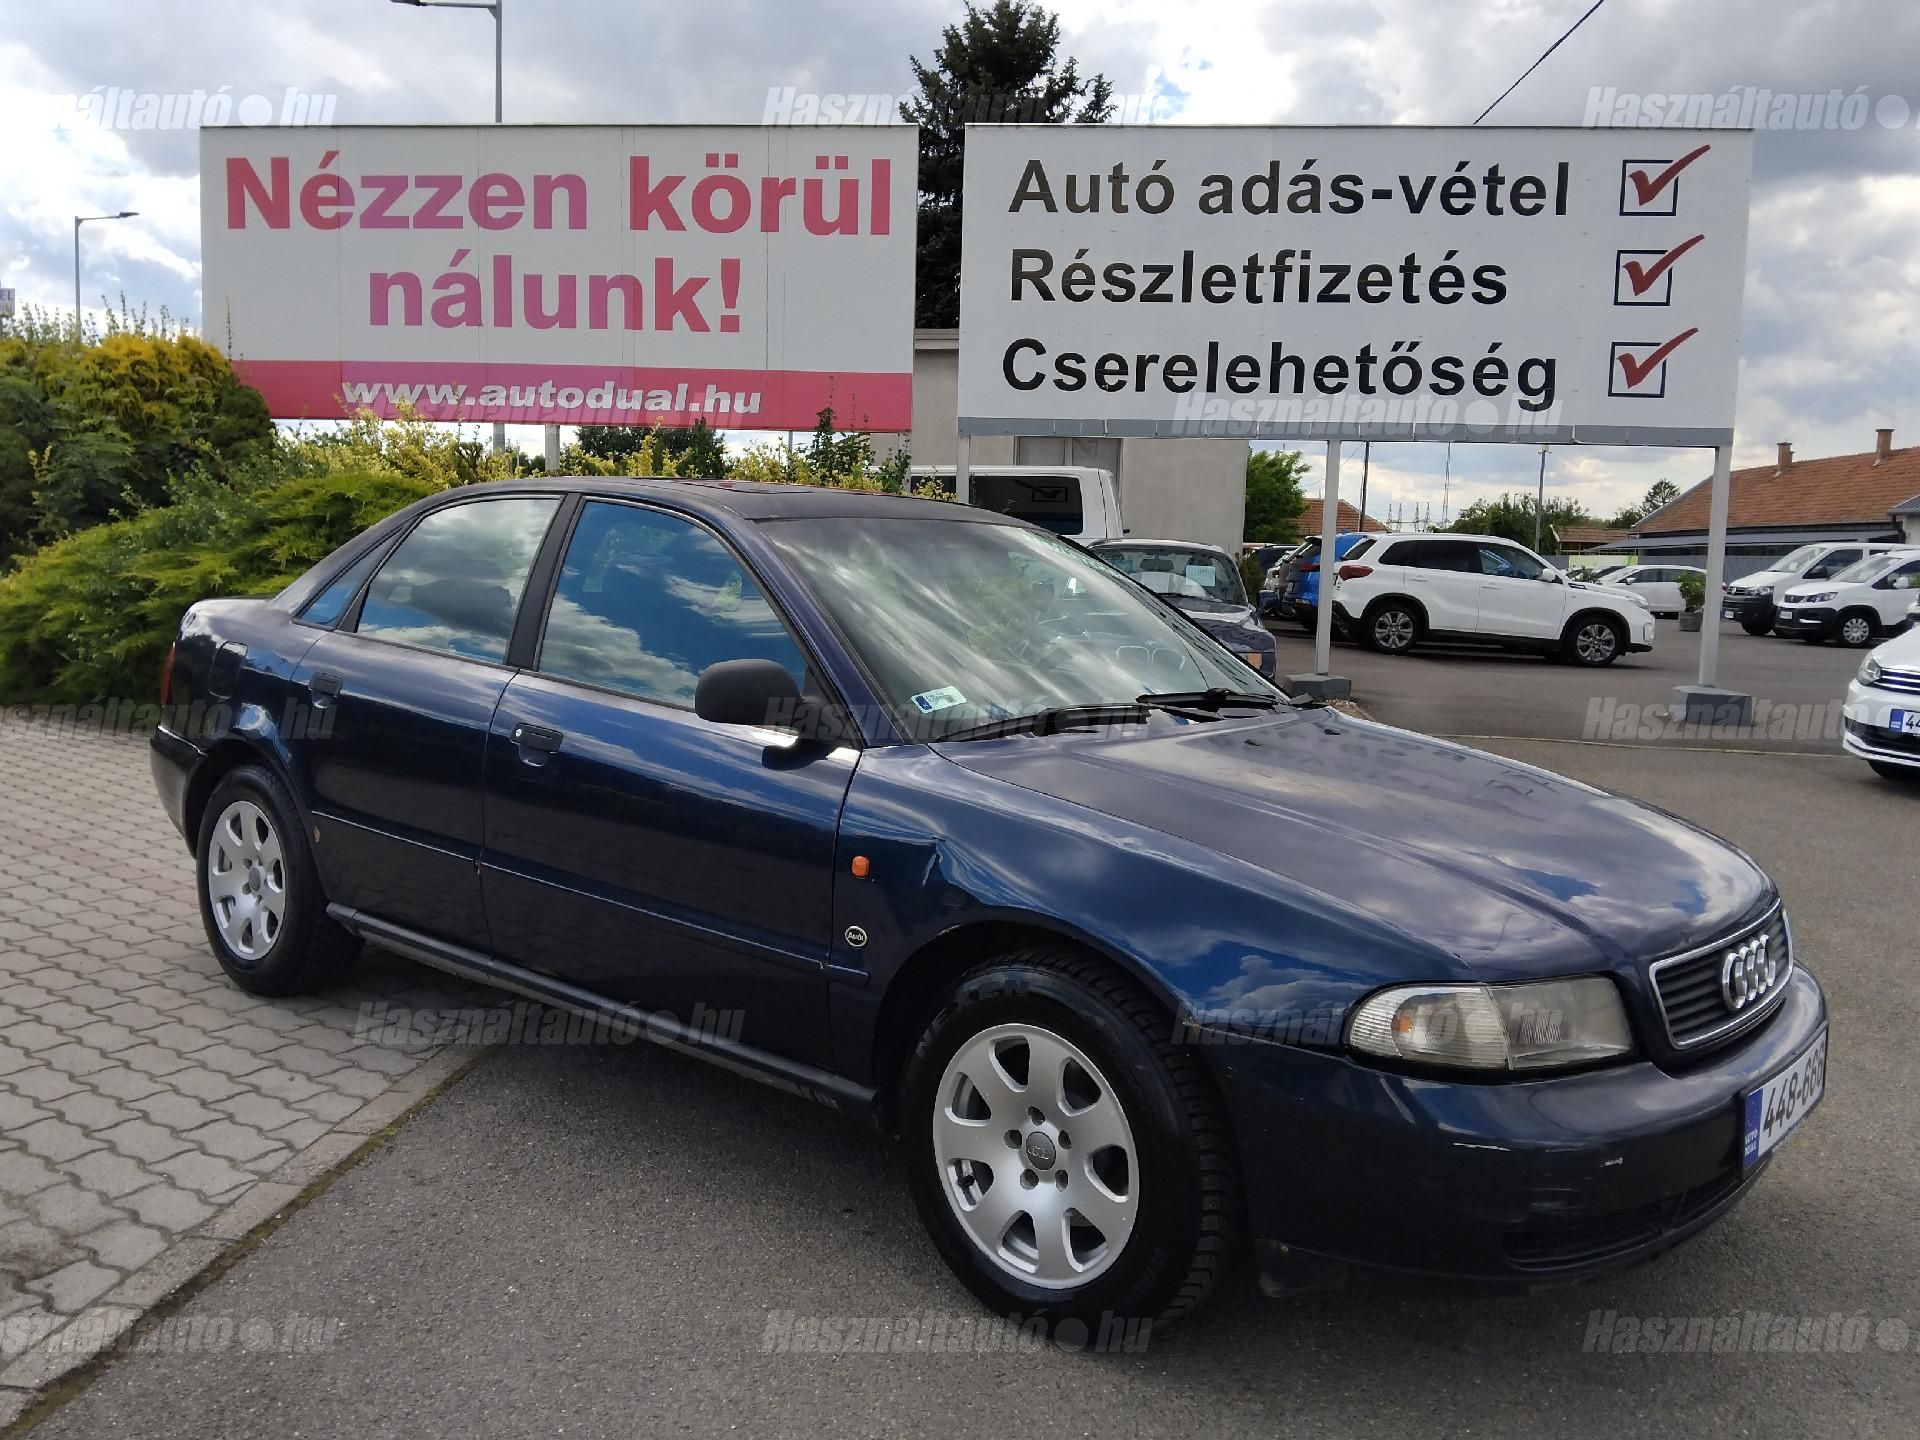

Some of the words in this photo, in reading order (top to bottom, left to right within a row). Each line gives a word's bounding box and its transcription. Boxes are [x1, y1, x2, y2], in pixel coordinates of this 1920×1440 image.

[226, 150, 588, 230] Nézzen
[629, 153, 891, 235] körül
[1009, 159, 1174, 213] Autó
[1198, 158, 1569, 216] adás-vétel
[369, 248, 741, 332] nálunk!
[1011, 248, 1507, 304] Részletfizetés
[342, 380, 761, 414] www.autodual.hu
[1002, 338, 1556, 412] Cserelehetőség
[1763, 1041, 1825, 1138] 448-666
